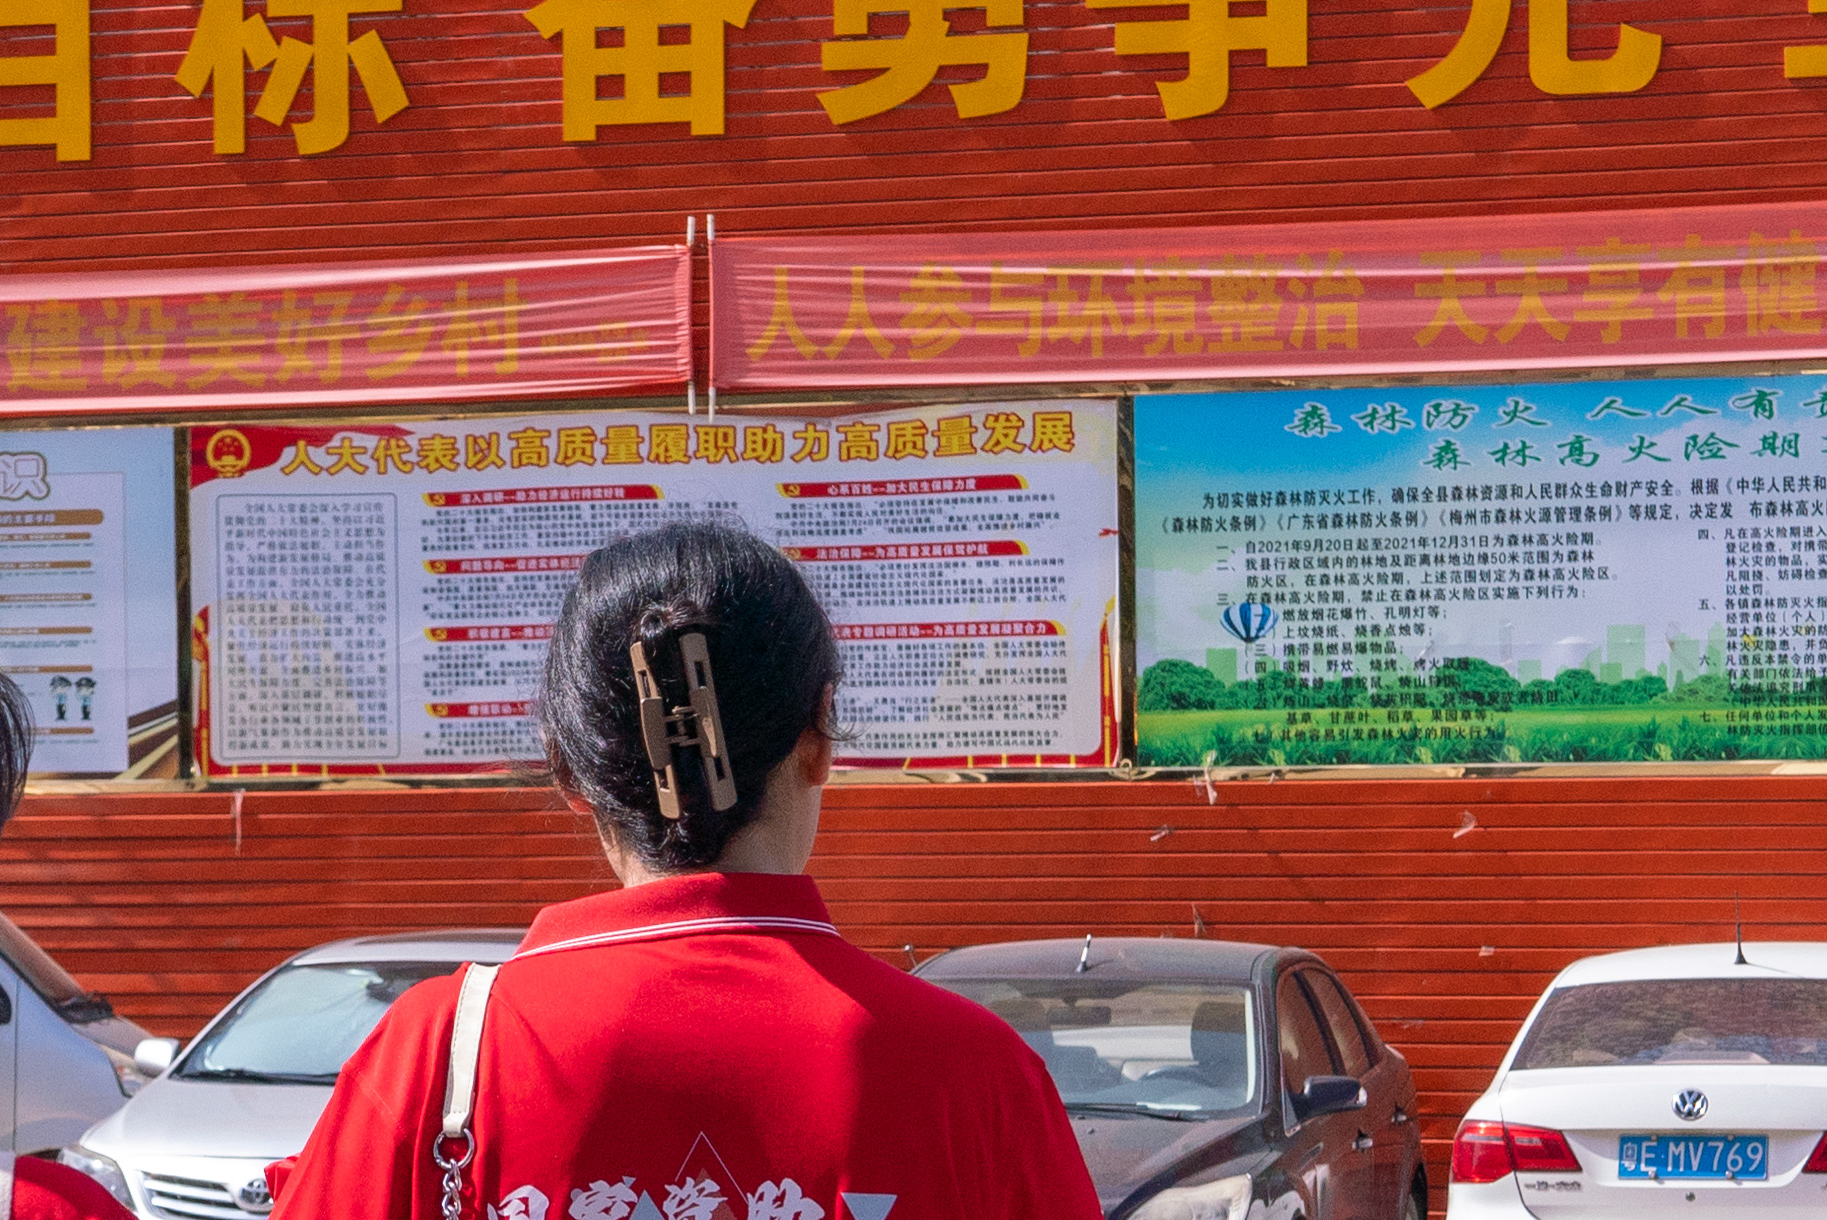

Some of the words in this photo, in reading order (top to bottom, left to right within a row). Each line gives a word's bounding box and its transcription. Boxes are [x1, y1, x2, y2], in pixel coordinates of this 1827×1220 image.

[746, 248, 1364, 361] 人人参与环境整治
[1413, 229, 1822, 347] 天天享有健
[5, 278, 528, 393] 建设美好乡村
[281, 411, 1076, 477] 人大代表以高质量履职助力高质量发展
[1287, 398, 1547, 436] 森林防火
[1426, 430, 1801, 470] 森林高火险期
